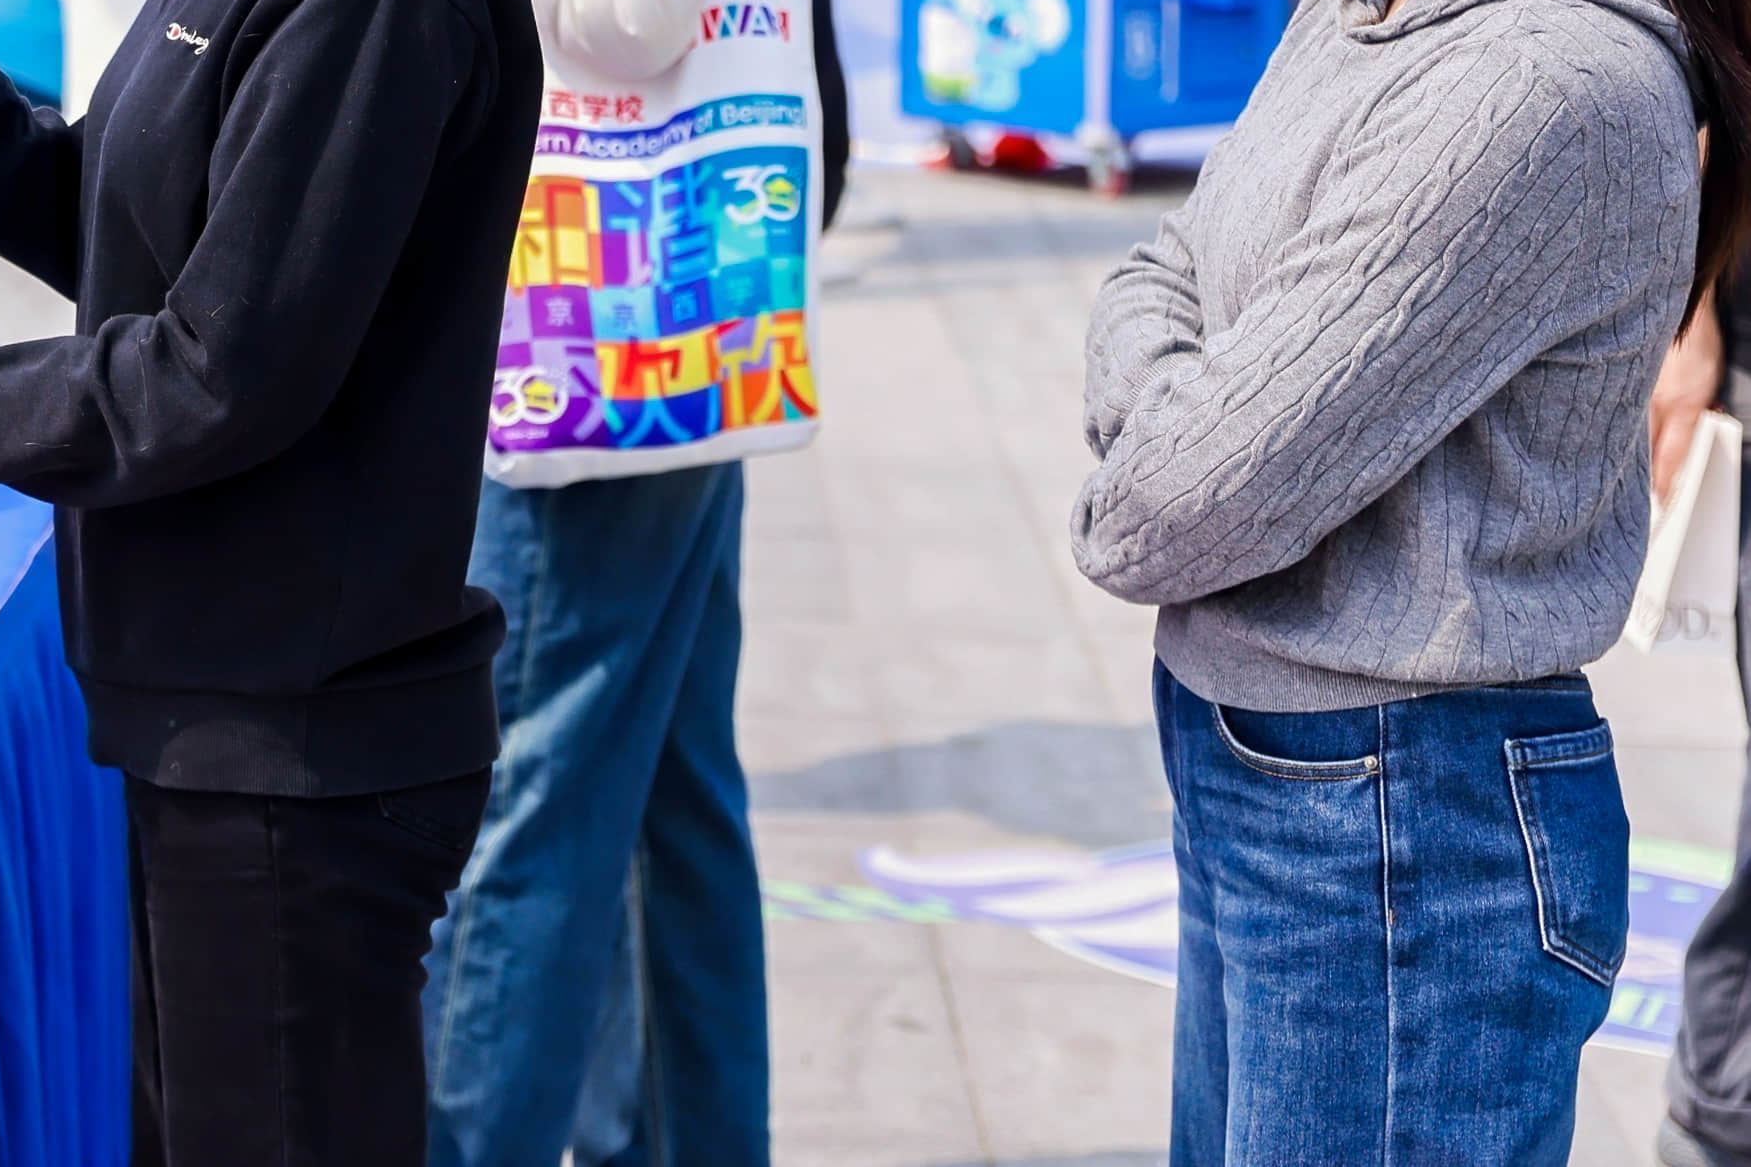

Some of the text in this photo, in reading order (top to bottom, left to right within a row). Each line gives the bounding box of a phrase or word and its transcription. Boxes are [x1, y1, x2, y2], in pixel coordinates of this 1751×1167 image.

[545, 90, 645, 125] 西学校
[719, 100, 806, 127] Beijing
